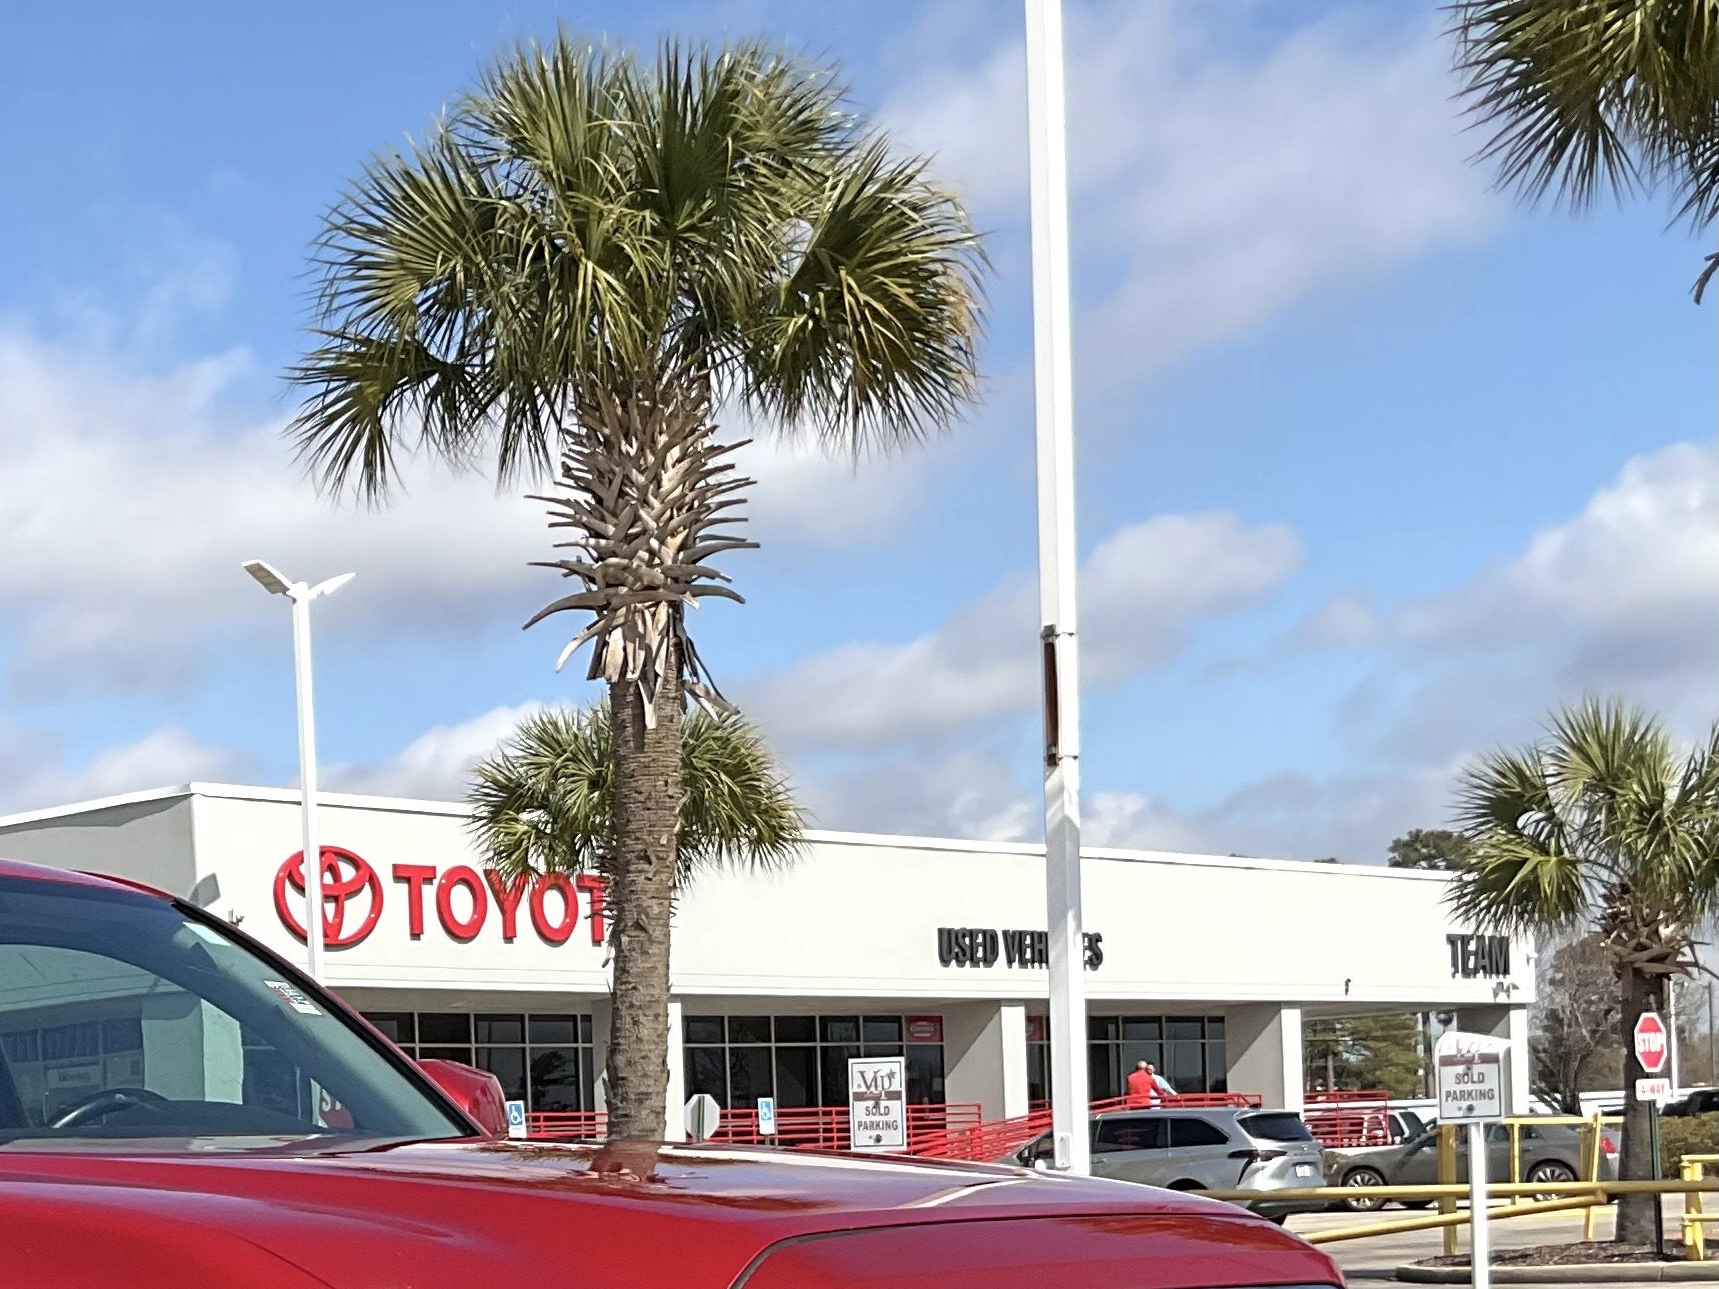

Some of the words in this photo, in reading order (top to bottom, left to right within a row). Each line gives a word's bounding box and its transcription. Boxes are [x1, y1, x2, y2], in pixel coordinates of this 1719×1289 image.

[392, 863, 613, 947] TOYOT
[937, 927, 999, 968] USED
[1001, 929, 1104, 971] VEHES
[1446, 933, 1510, 979] TEAM
[1637, 1032, 1666, 1053] STOP
[1454, 1071, 1485, 1085] SOLD
[1445, 1088, 1495, 1102] PARKING
[865, 1105, 890, 1117] SOLD
[857, 1119, 899, 1132] PARKING
